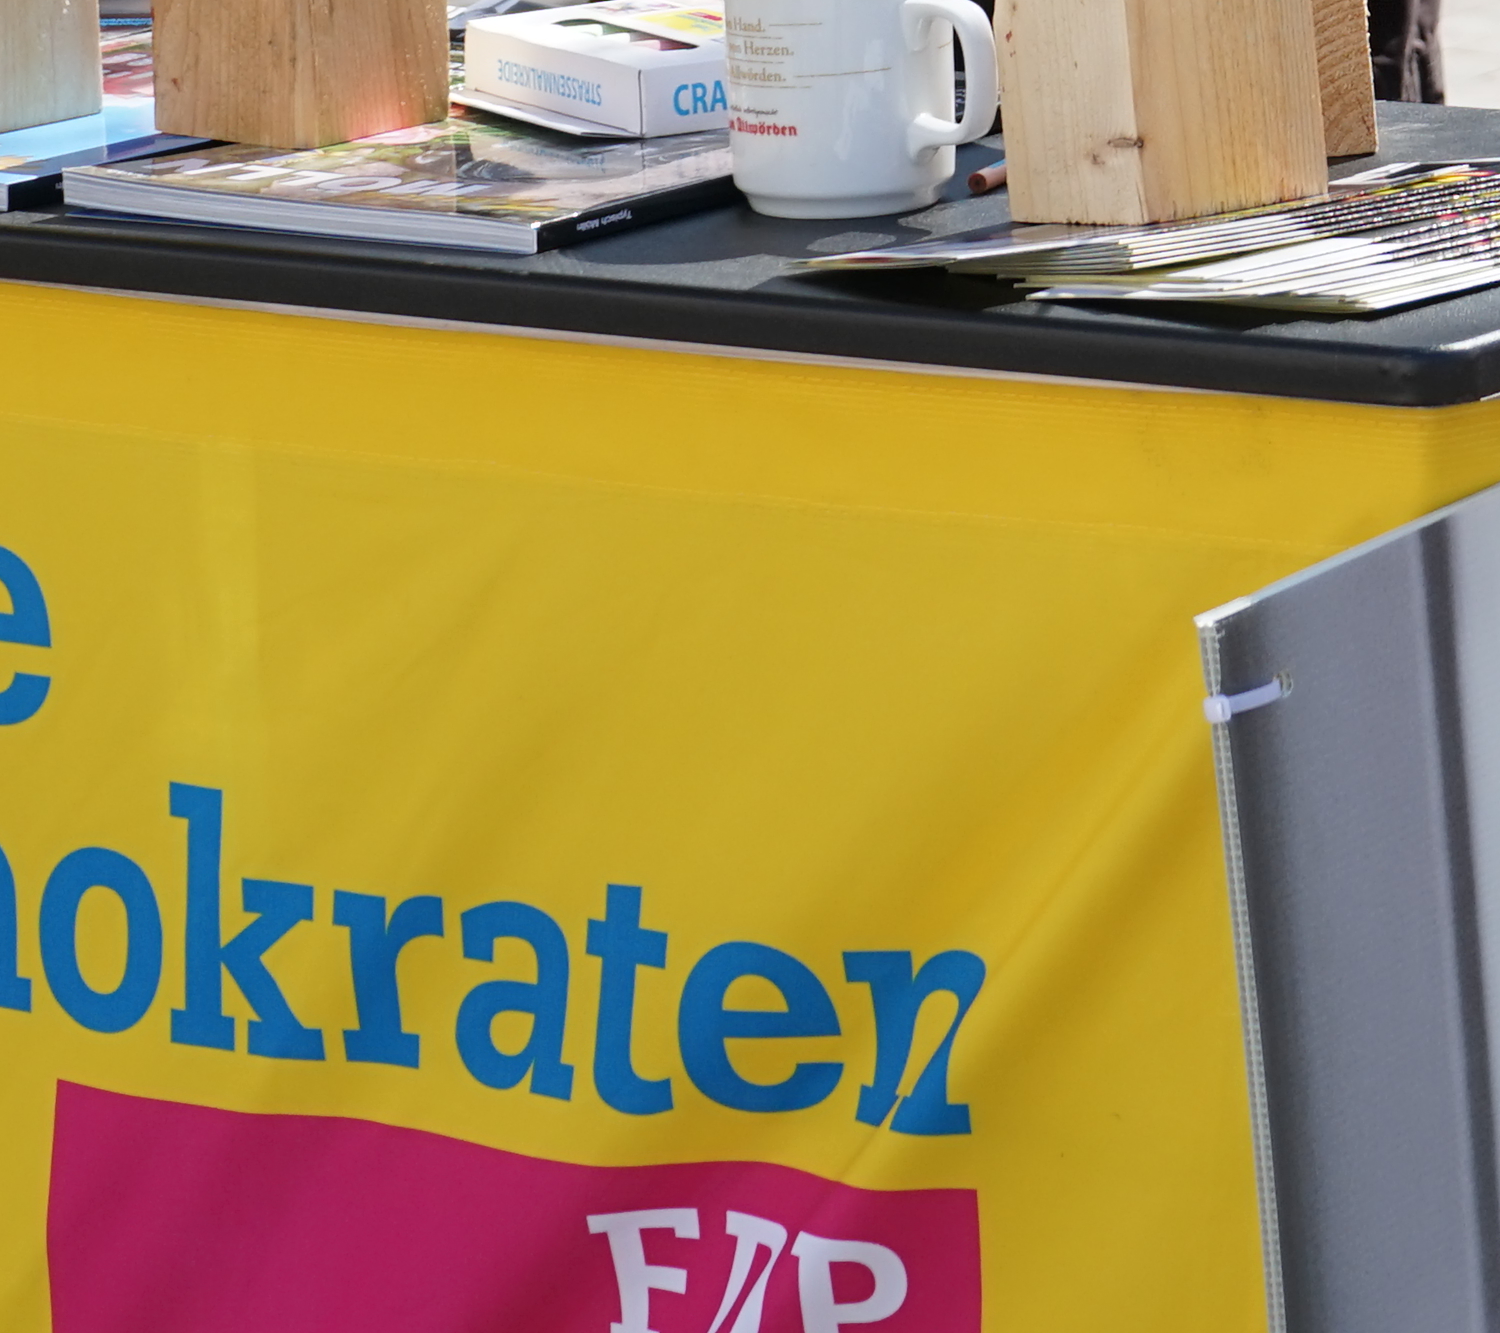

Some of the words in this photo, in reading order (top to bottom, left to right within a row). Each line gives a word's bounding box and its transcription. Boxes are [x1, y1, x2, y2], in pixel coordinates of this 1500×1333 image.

[743, 40, 795, 57] Herzen.
[497, 58, 603, 107] STRASSENMALKREIDE
[673, 79, 728, 117] CRA
